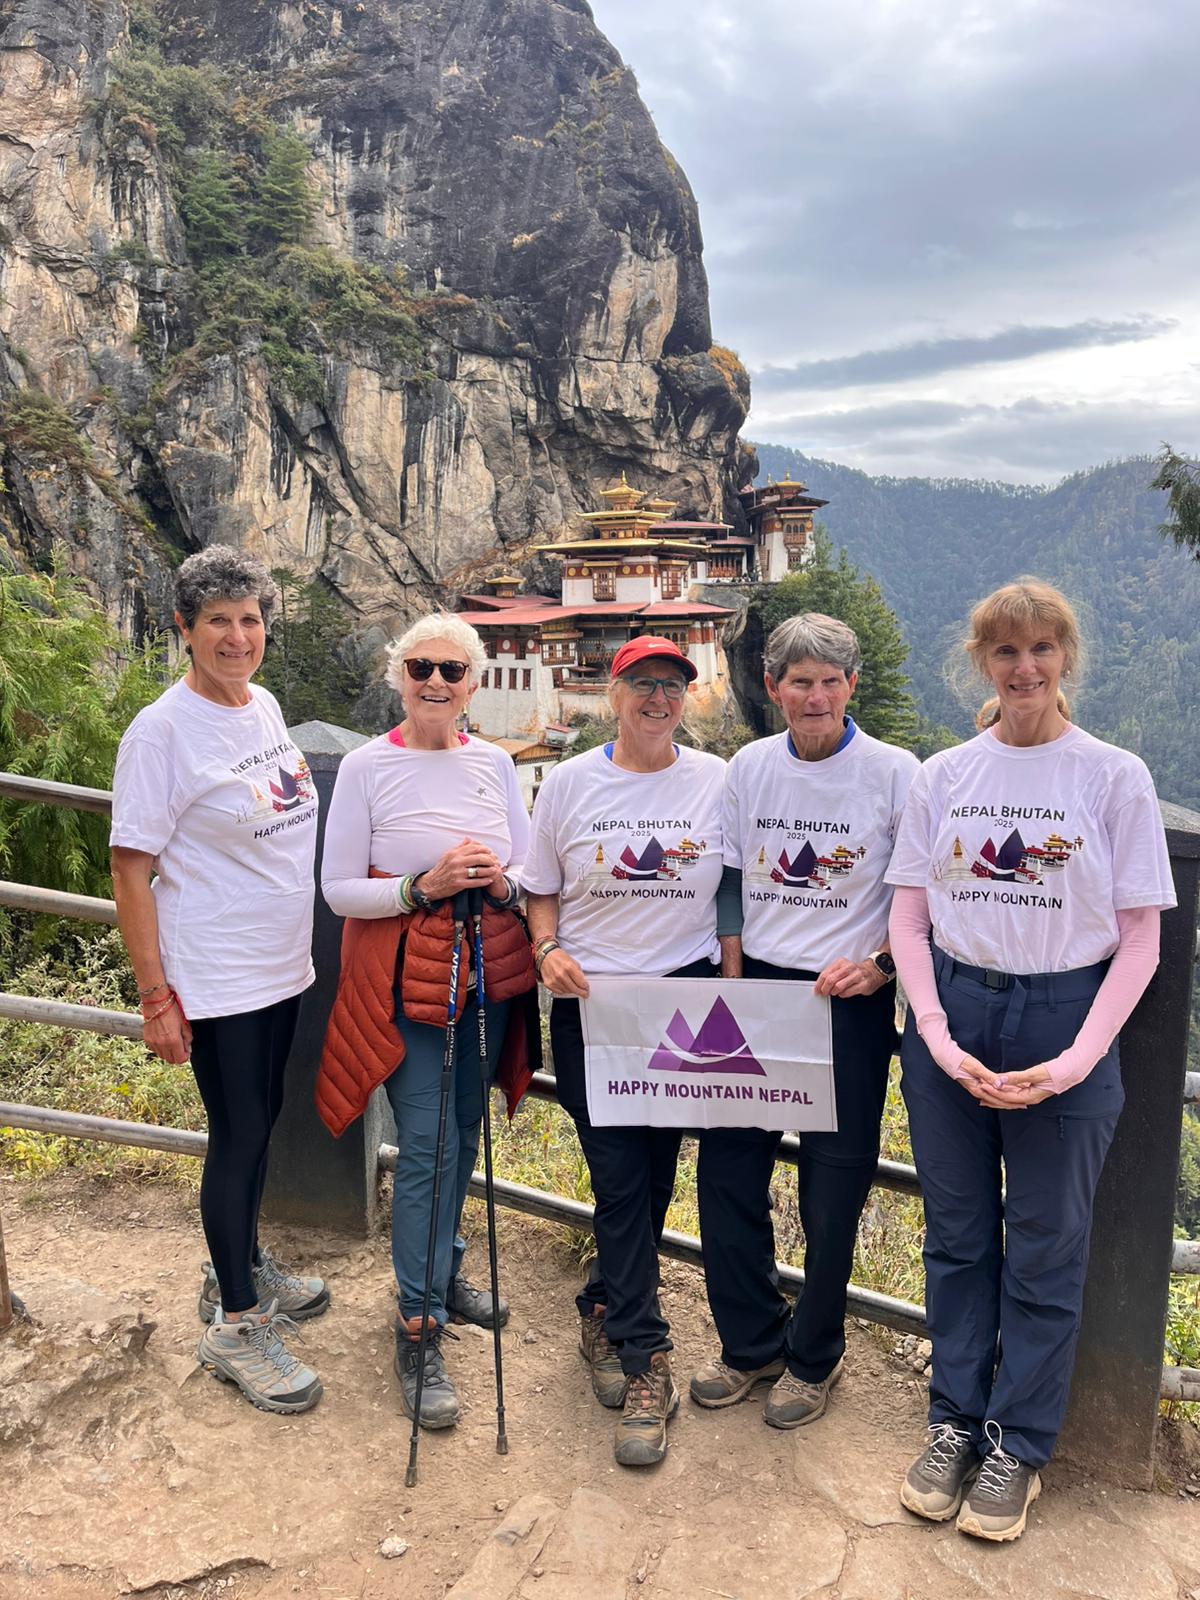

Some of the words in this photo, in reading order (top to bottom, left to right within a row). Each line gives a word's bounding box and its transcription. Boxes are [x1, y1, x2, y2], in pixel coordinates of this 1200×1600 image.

[230, 752, 264, 775] NEPAL
[950, 806, 997, 818] NEPAL
[1001, 806, 1065, 822] BHUTAN
[254, 822, 286, 839] HAPPY
[287, 808, 318, 828] MOUNT
[592, 820, 633, 832] NEPAL
[637, 820, 692, 830] BHUTAN
[757, 818, 790, 830] NEPAL
[794, 820, 850, 834] BHUTAN
[994, 819, 1014, 828] 2025
[786, 832, 806, 840] 2025
[590, 889, 628, 899] HAPPY
[631, 889, 696, 899] MOUNTAIN
[782, 895, 848, 908] MOUNTAIN
[449, 951, 459, 1004] FIZAN
[608, 1080, 659, 1097] HAPPY
[665, 1083, 753, 1101] MOUNTAIN
[759, 1087, 813, 1106] NEPAL
